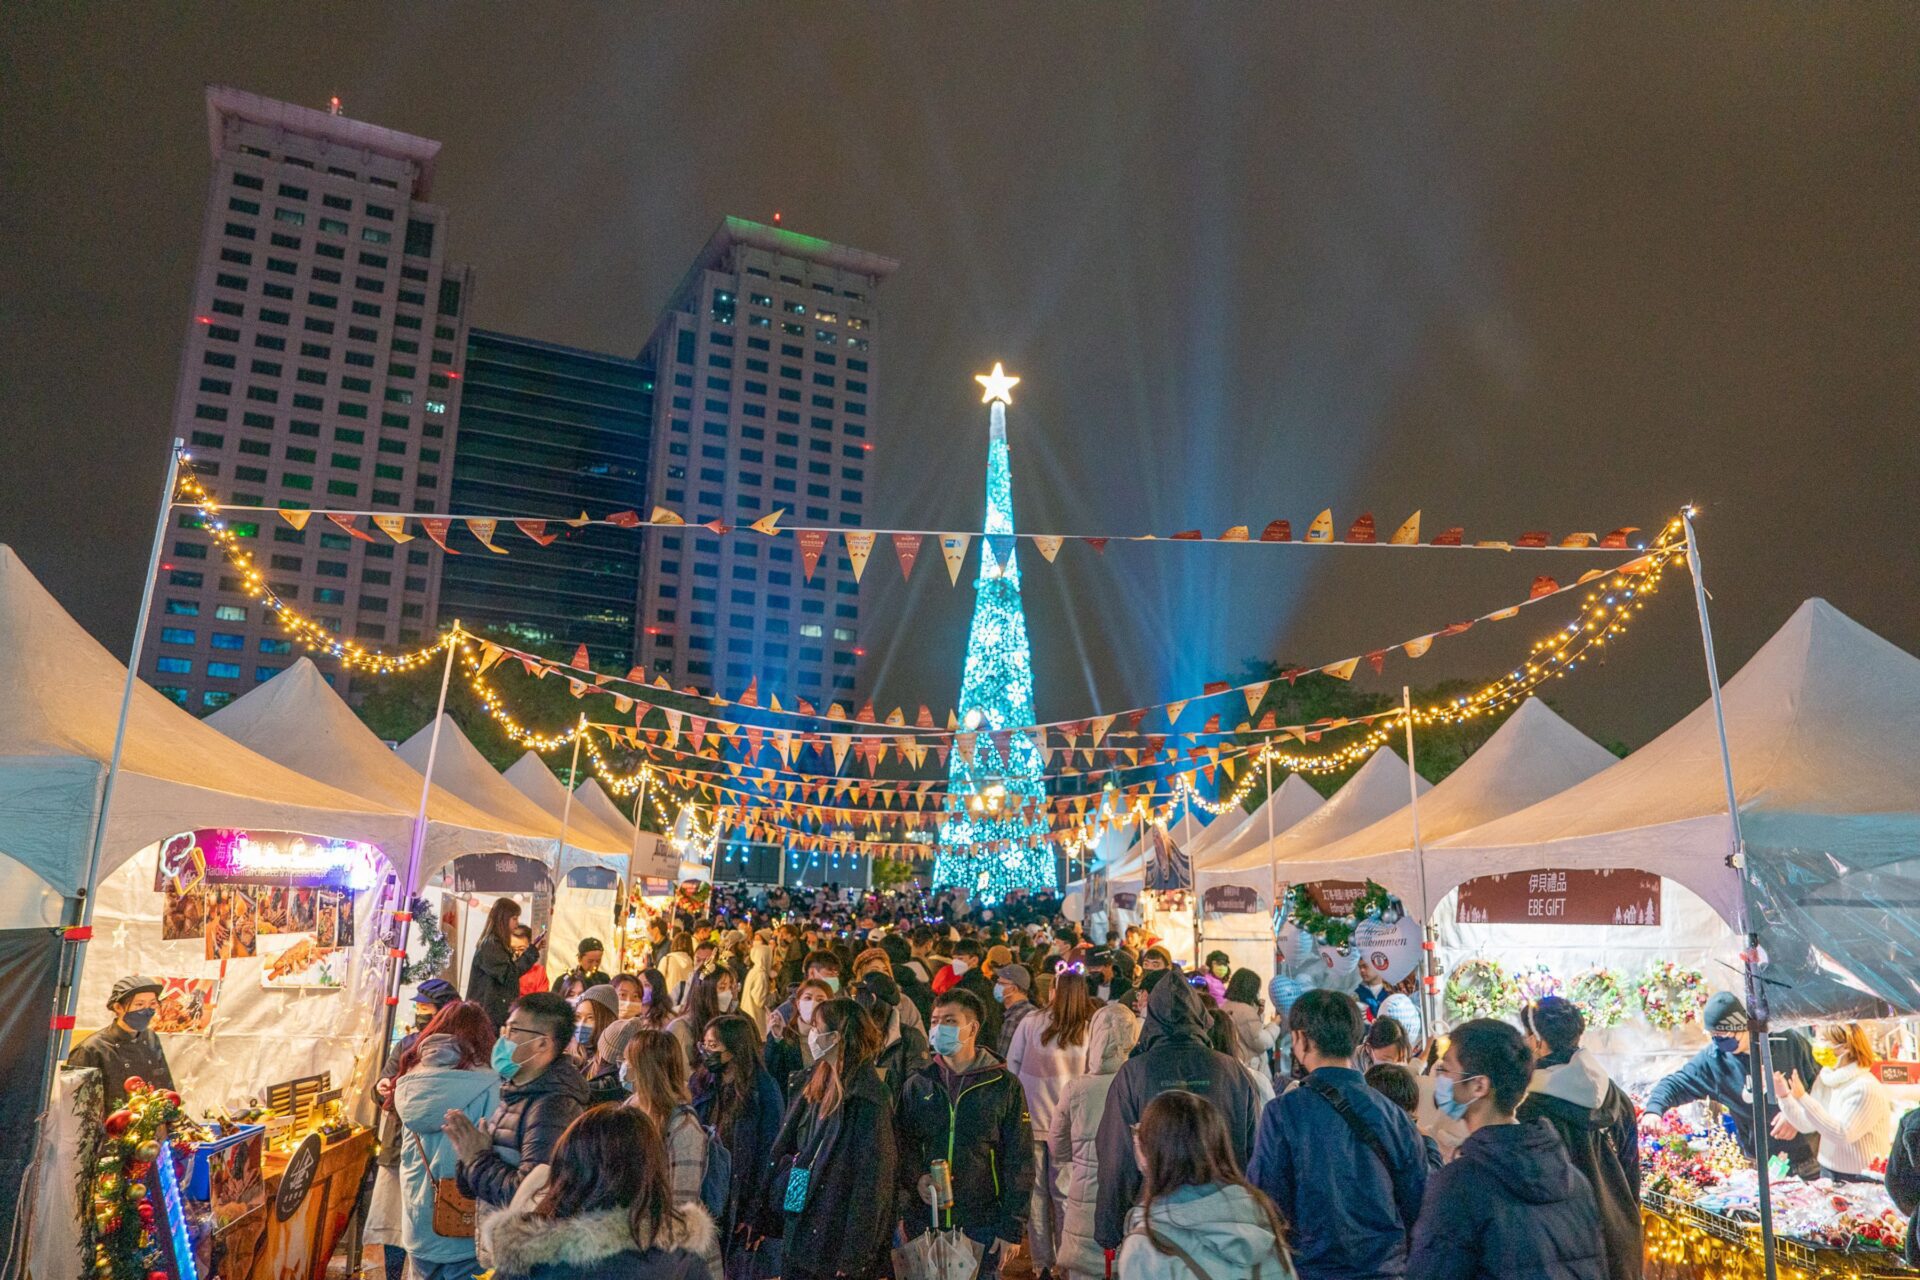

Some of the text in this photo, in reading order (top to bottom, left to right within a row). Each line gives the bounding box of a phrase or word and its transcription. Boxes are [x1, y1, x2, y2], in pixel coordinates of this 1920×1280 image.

[1528, 872, 1567, 893] 伊貝禮品
[1528, 898, 1566, 916] EBE GIFT
[1716, 1023, 1748, 1031] adid
